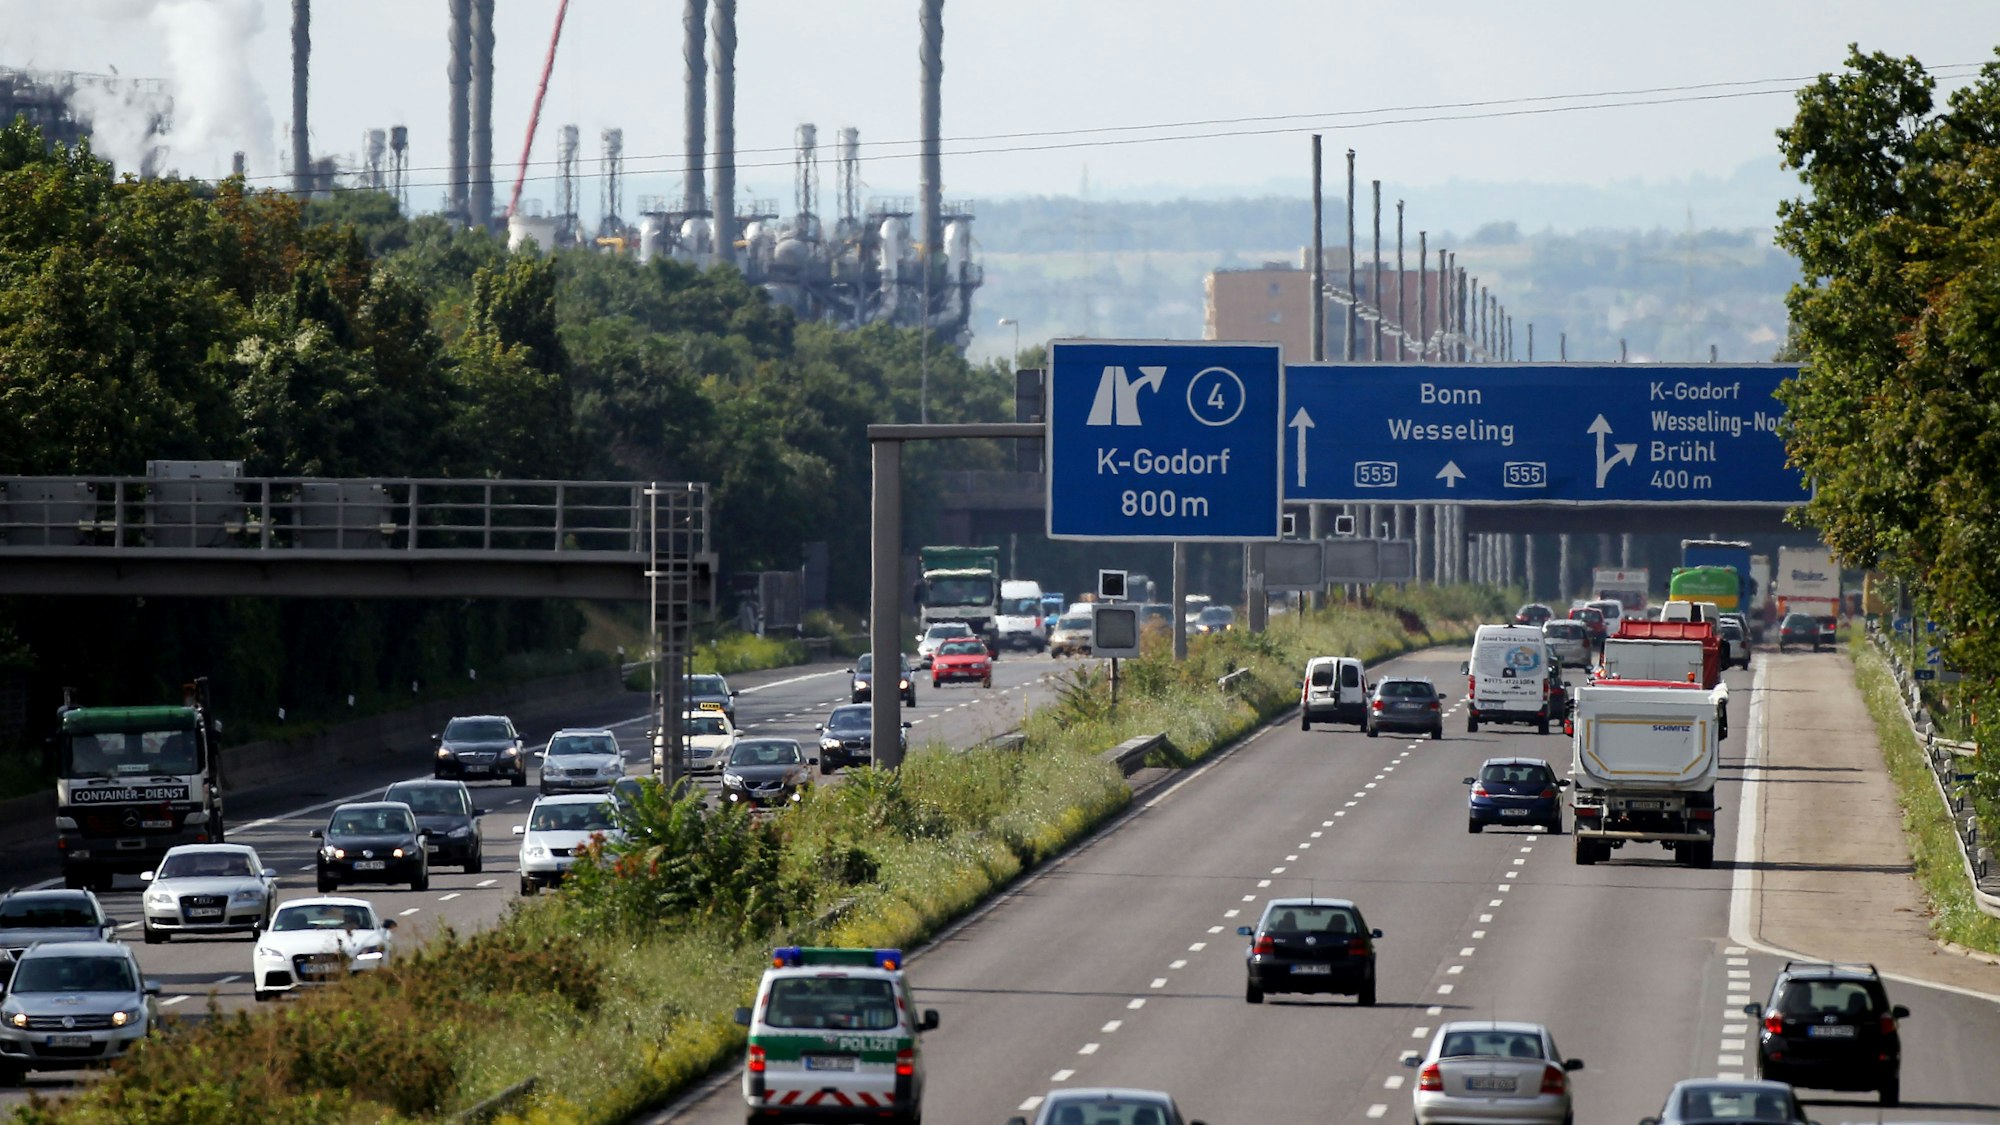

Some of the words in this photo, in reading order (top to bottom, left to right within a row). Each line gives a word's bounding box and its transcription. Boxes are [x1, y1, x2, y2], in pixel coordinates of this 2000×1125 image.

[1207, 383, 1225, 410] 4
[1420, 383, 1482, 405] Bonn
[1650, 382, 1741, 401] K-Godorf
[1388, 419, 1515, 447] Wesseling
[1651, 411, 1783, 438] Wesseling-Nor
[1097, 448, 1231, 475] K-Godorf
[1651, 440, 1717, 462] Brühl
[1360, 467, 1392, 482] 555
[1509, 467, 1541, 483] 555
[1651, 471, 1689, 489] 400
[1693, 474, 1712, 489] m
[1121, 490, 1176, 517] 800
[1182, 495, 1209, 517] m
[75, 787, 185, 802] CONTAINER-DIENST
[840, 1038, 898, 1051] POLIZEI
